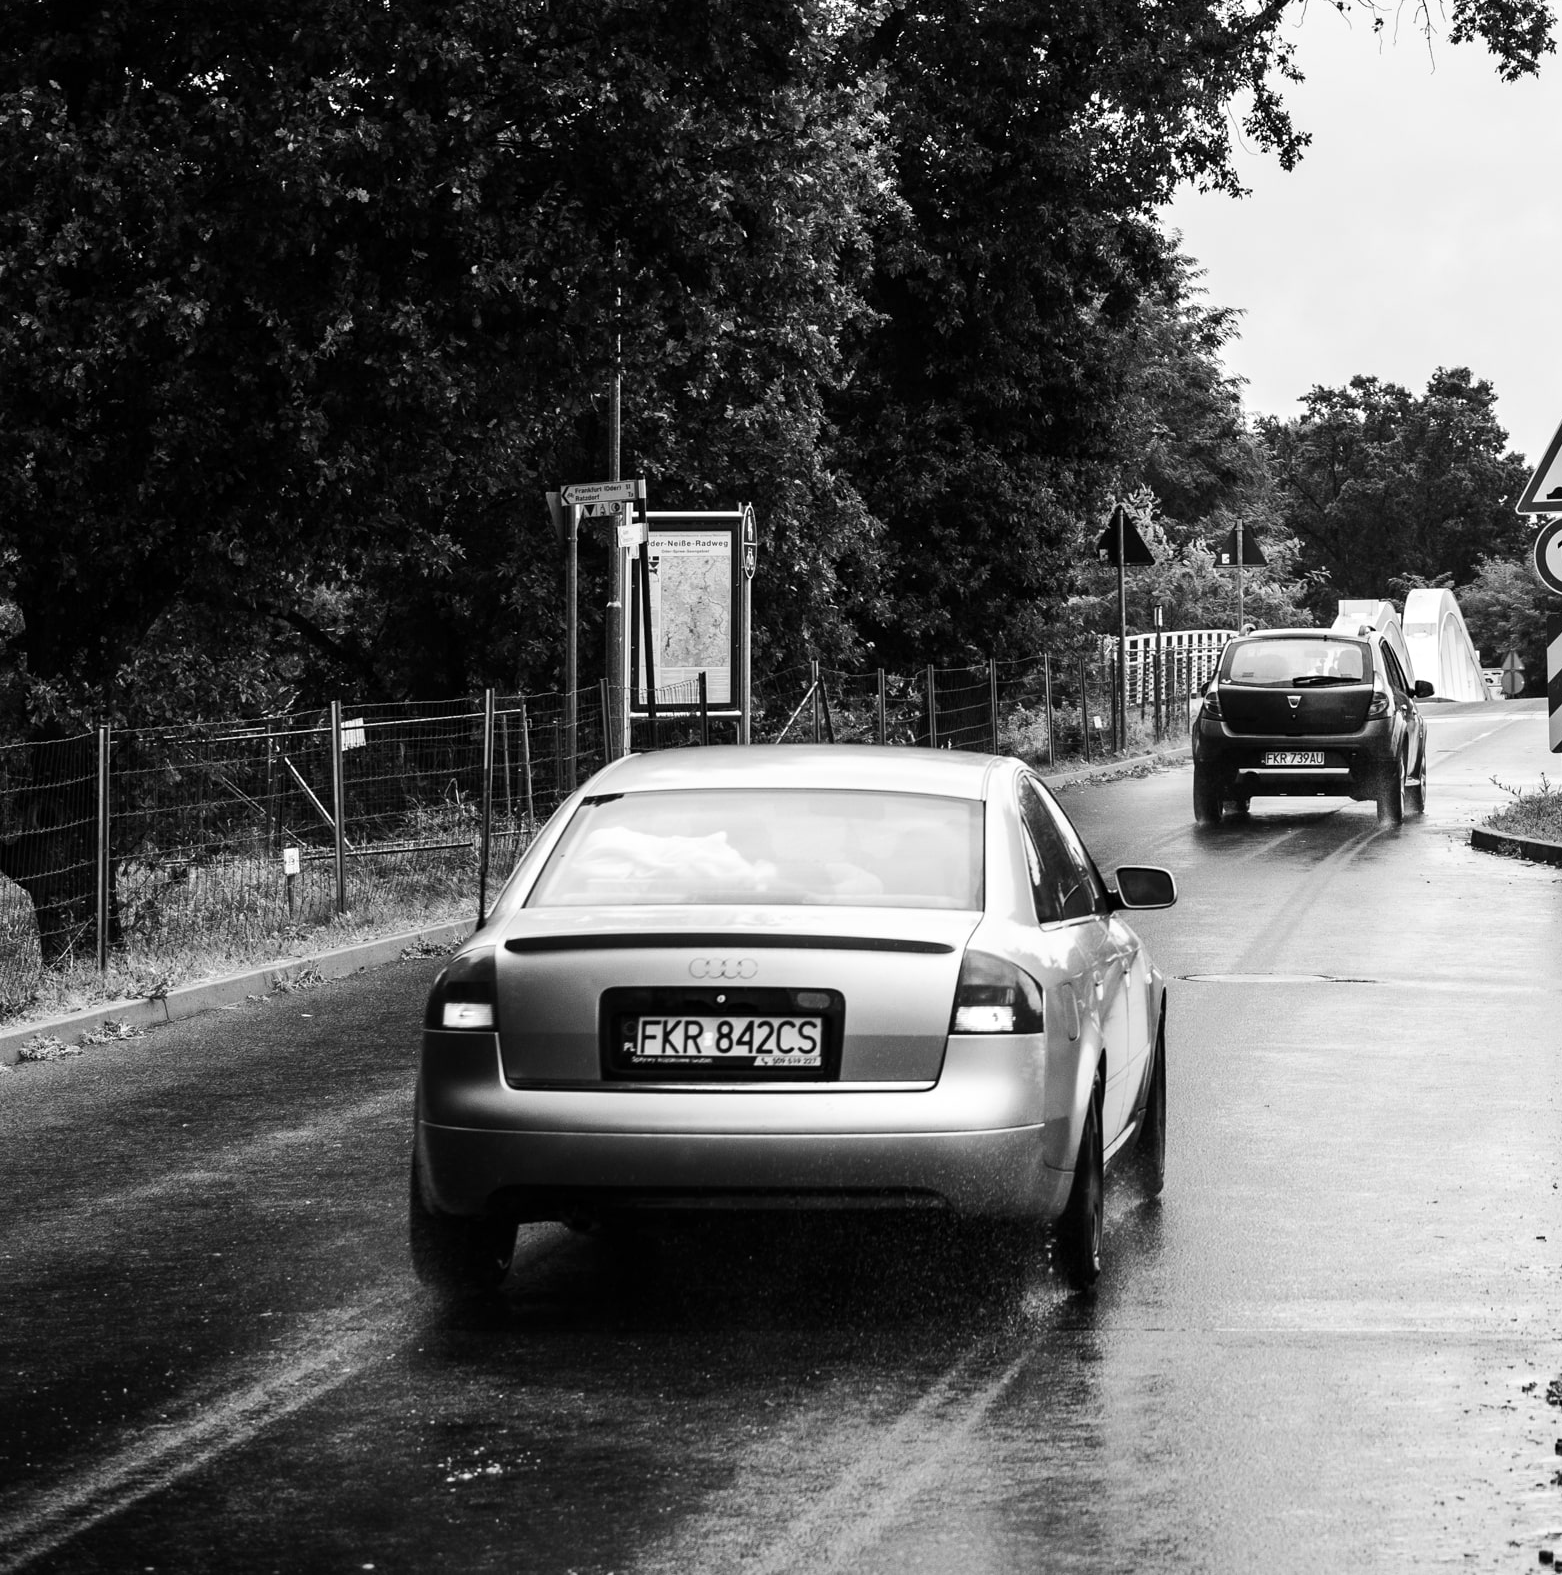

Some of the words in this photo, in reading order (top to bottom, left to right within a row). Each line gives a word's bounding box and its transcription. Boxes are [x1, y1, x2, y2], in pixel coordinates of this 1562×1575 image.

[574, 486, 602, 494] Frankfurt
[575, 494, 600, 502] Ratzdorf
[1266, 752, 1287, 764] FKR
[1290, 752, 1324, 764] 739AU
[640, 1019, 704, 1055] FKR
[715, 1019, 818, 1055] 842CS
[623, 1042, 636, 1051] PL
